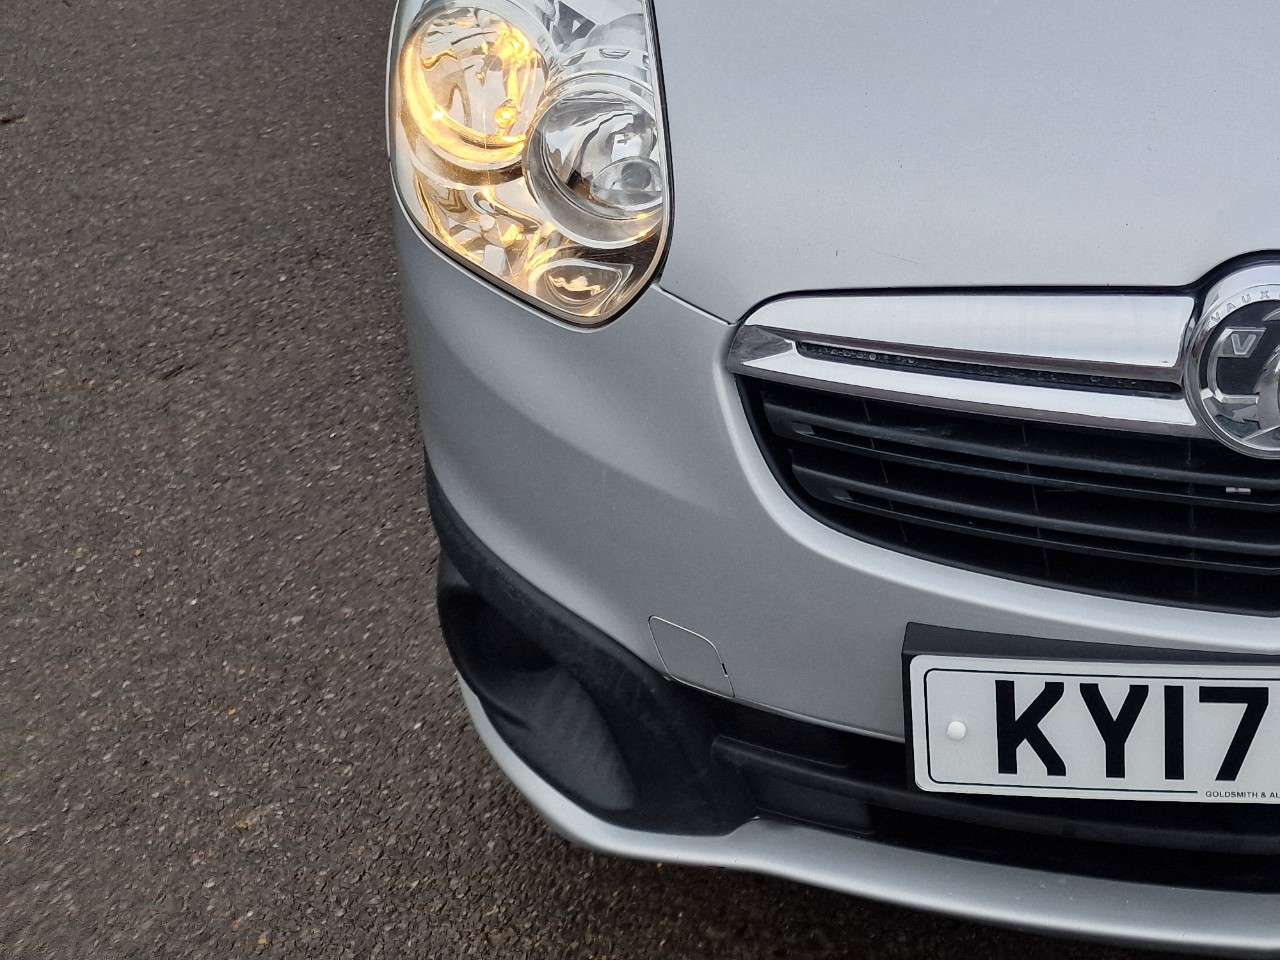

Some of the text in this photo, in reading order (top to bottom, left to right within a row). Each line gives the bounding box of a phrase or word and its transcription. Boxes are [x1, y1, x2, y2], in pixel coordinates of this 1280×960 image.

[995, 678, 1269, 782] KY17
[1205, 790, 1258, 799] GOLDSMITH
[1260, 791, 1267, 799] &
